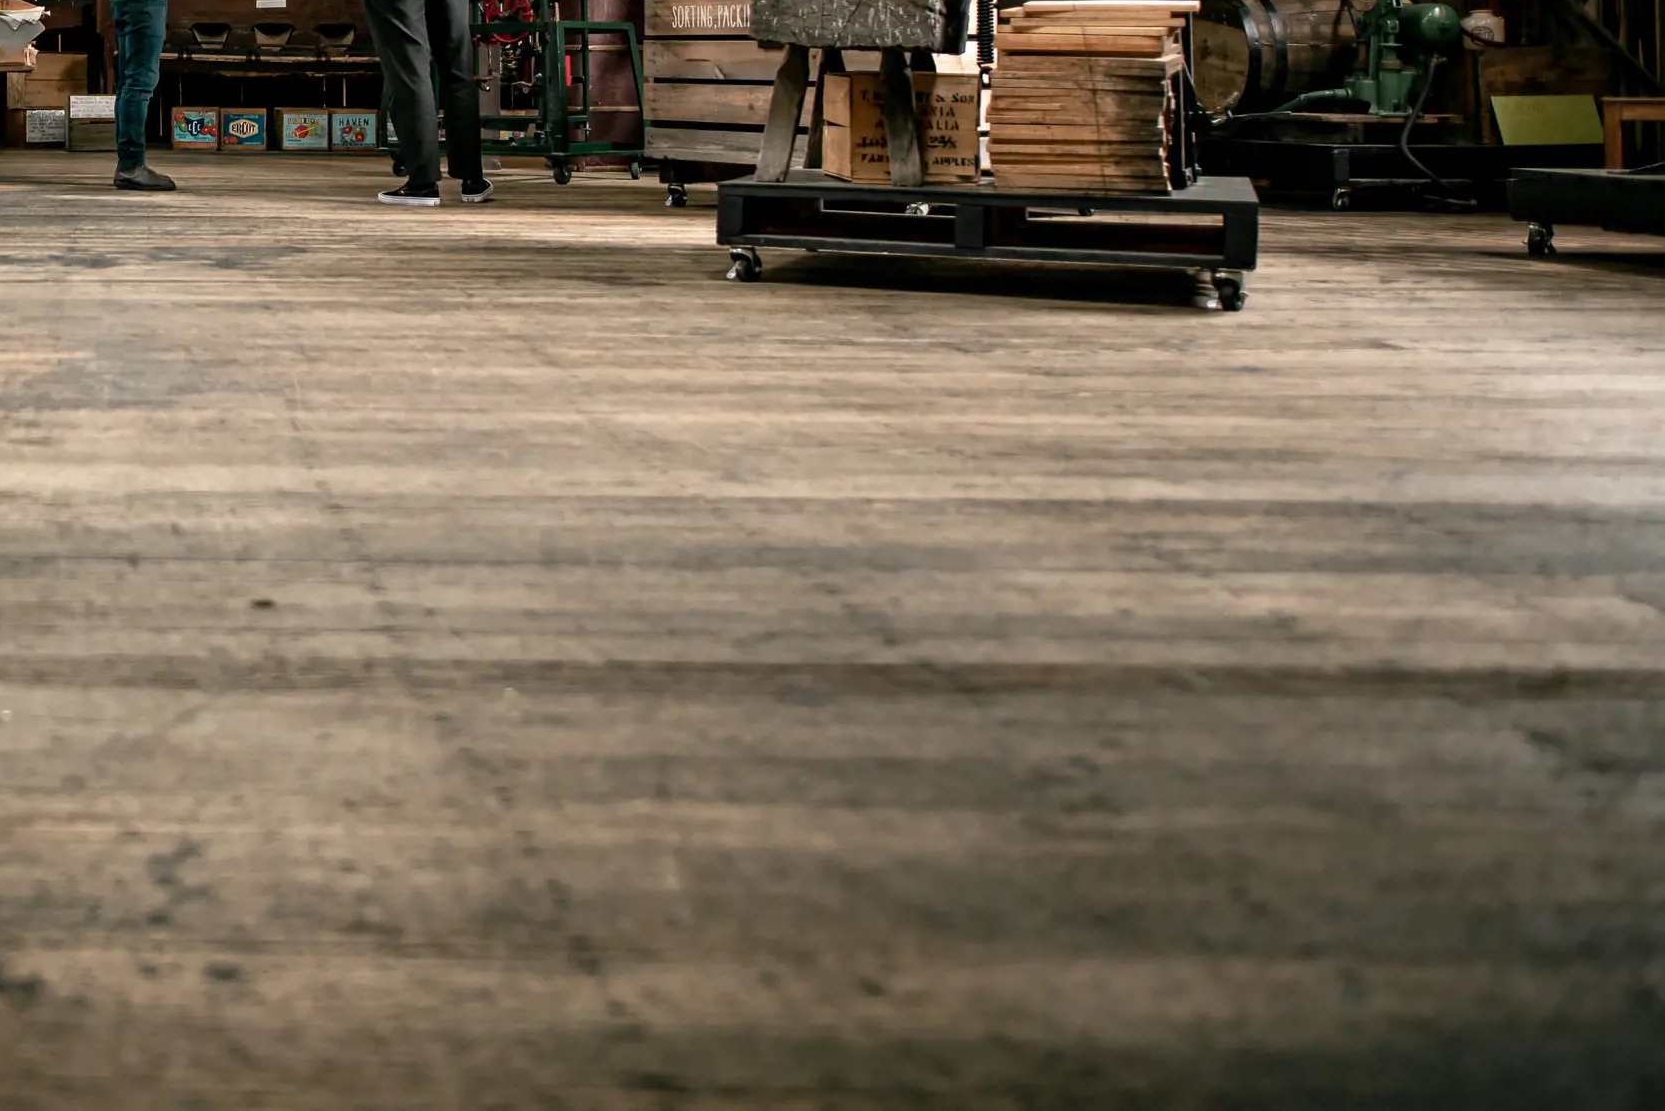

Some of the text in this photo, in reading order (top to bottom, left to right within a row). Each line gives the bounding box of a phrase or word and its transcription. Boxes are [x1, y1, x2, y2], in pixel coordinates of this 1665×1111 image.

[339, 117, 370, 127] HAVEN
[231, 121, 256, 135] ERCOT
[933, 157, 975, 167] APPLES
